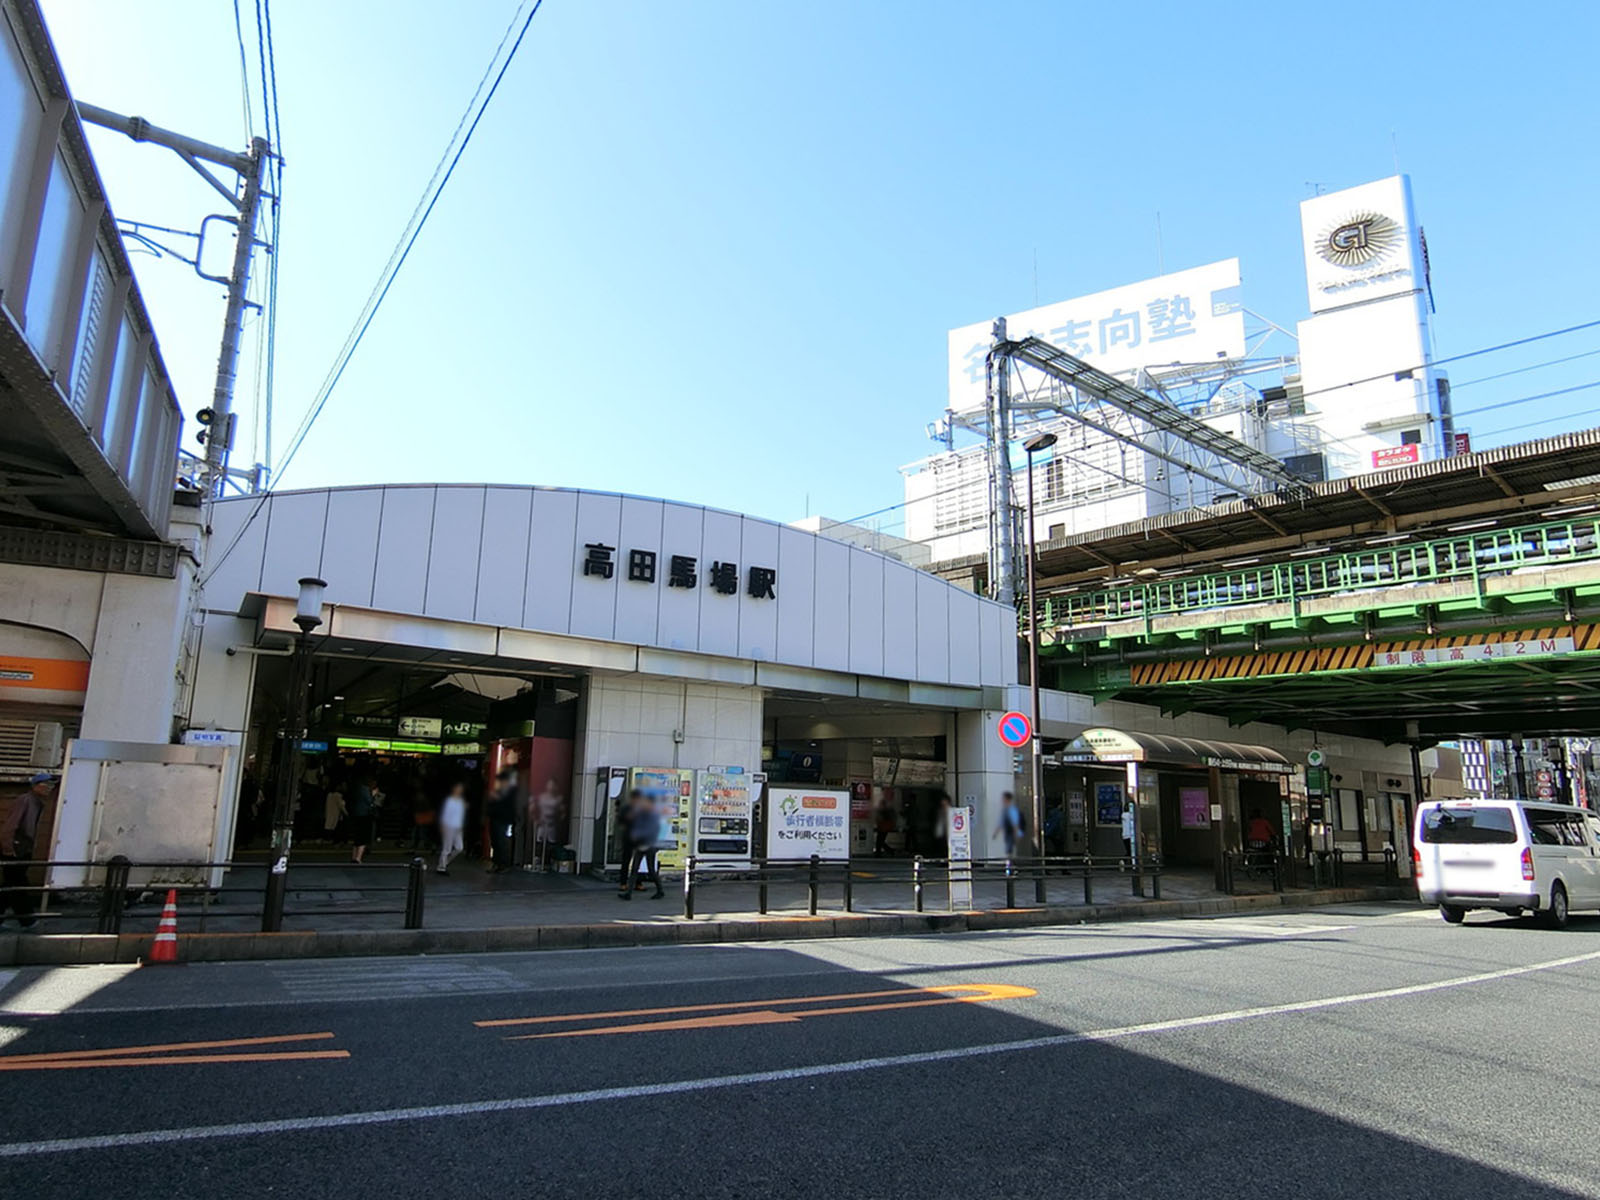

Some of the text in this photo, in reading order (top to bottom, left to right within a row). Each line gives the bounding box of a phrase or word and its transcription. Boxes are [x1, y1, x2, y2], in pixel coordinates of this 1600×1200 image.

[584, 542, 777, 601] 高田馬場駅
[454, 722, 471, 733] JR
[778, 830, 842, 840] をご利用ください
